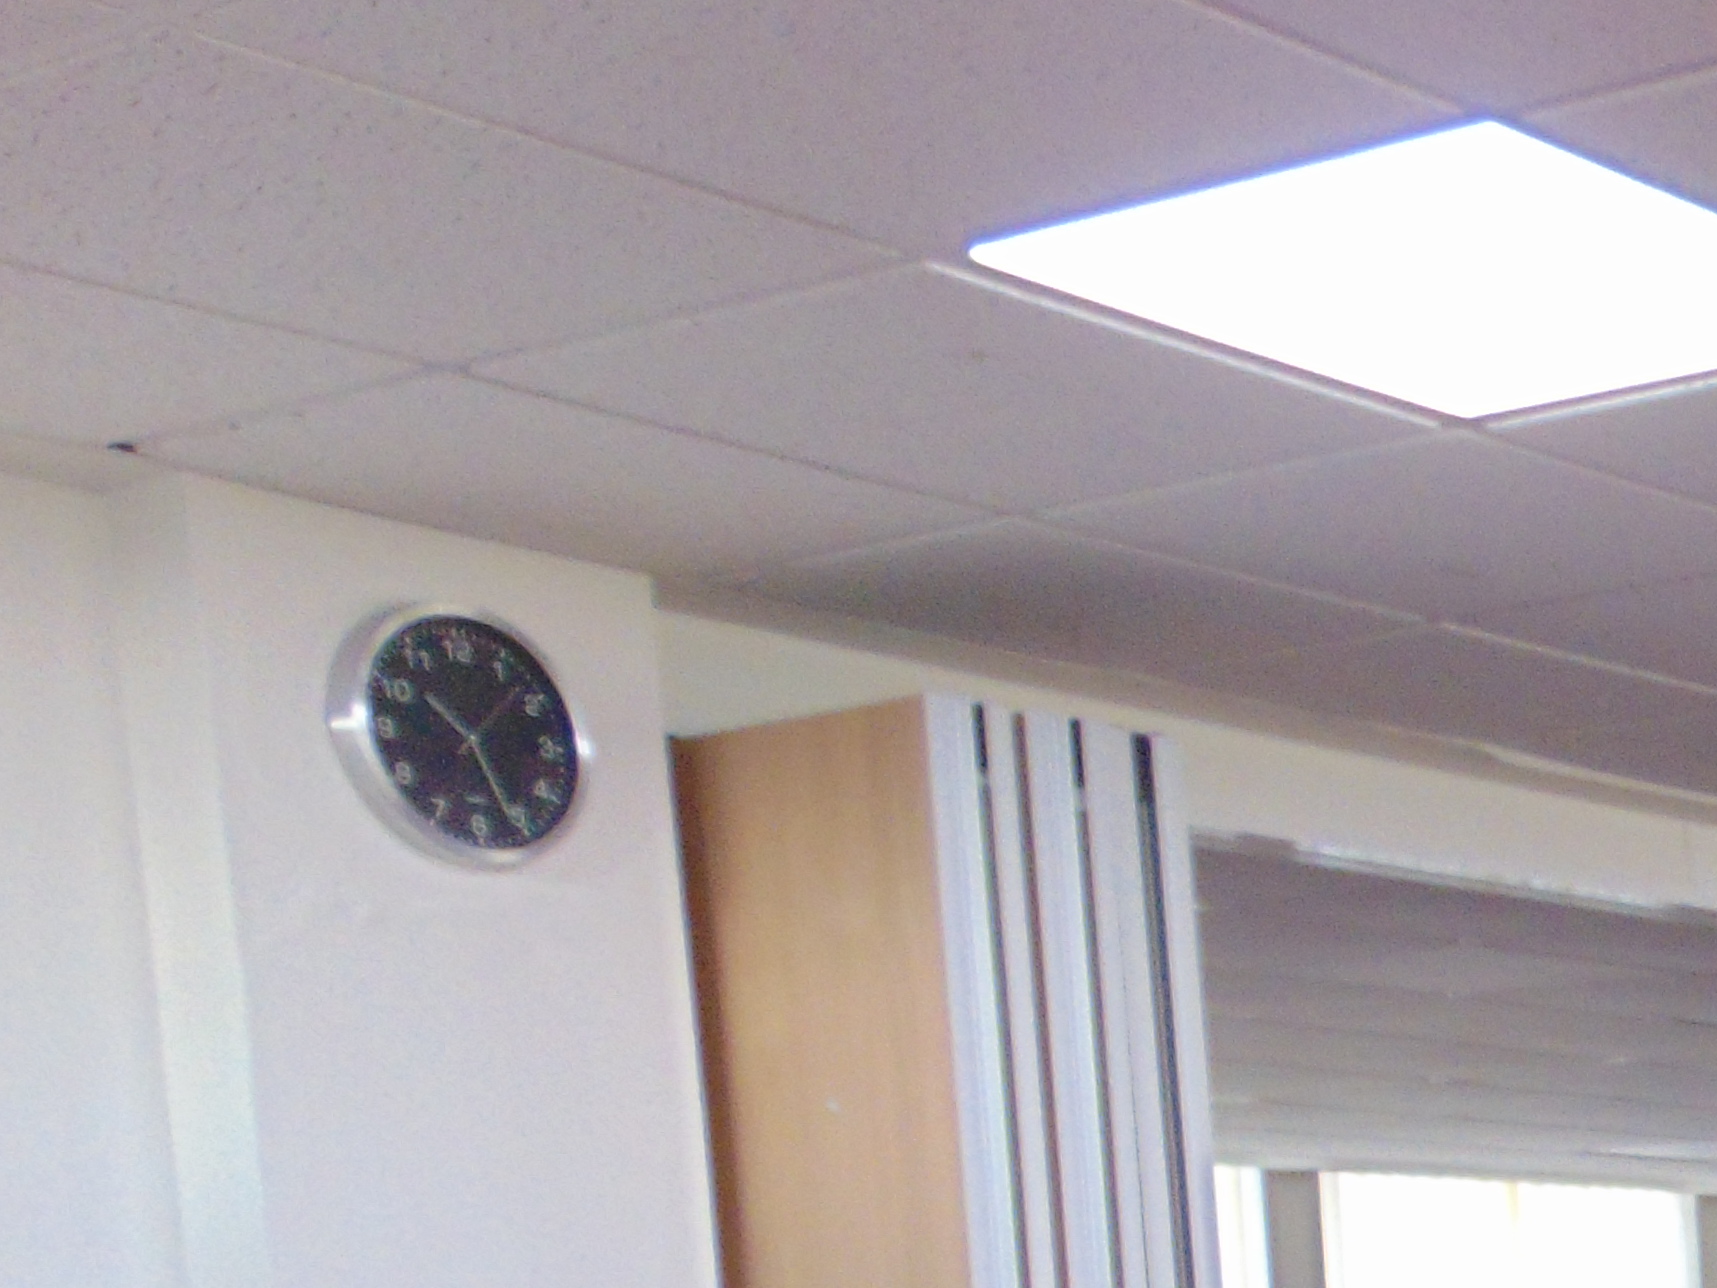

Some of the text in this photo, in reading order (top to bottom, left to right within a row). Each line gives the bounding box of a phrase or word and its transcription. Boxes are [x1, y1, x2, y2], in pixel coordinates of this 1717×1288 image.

[404, 648, 431, 672] 11
[443, 637, 474, 664] 12
[381, 677, 414, 704] 10
[524, 692, 546, 717] 2
[376, 715, 395, 740] 9
[537, 735, 557, 760] 3
[394, 760, 414, 787] 8
[533, 778, 559, 804] 4
[430, 797, 446, 820] 7
[469, 813, 489, 837] 6
